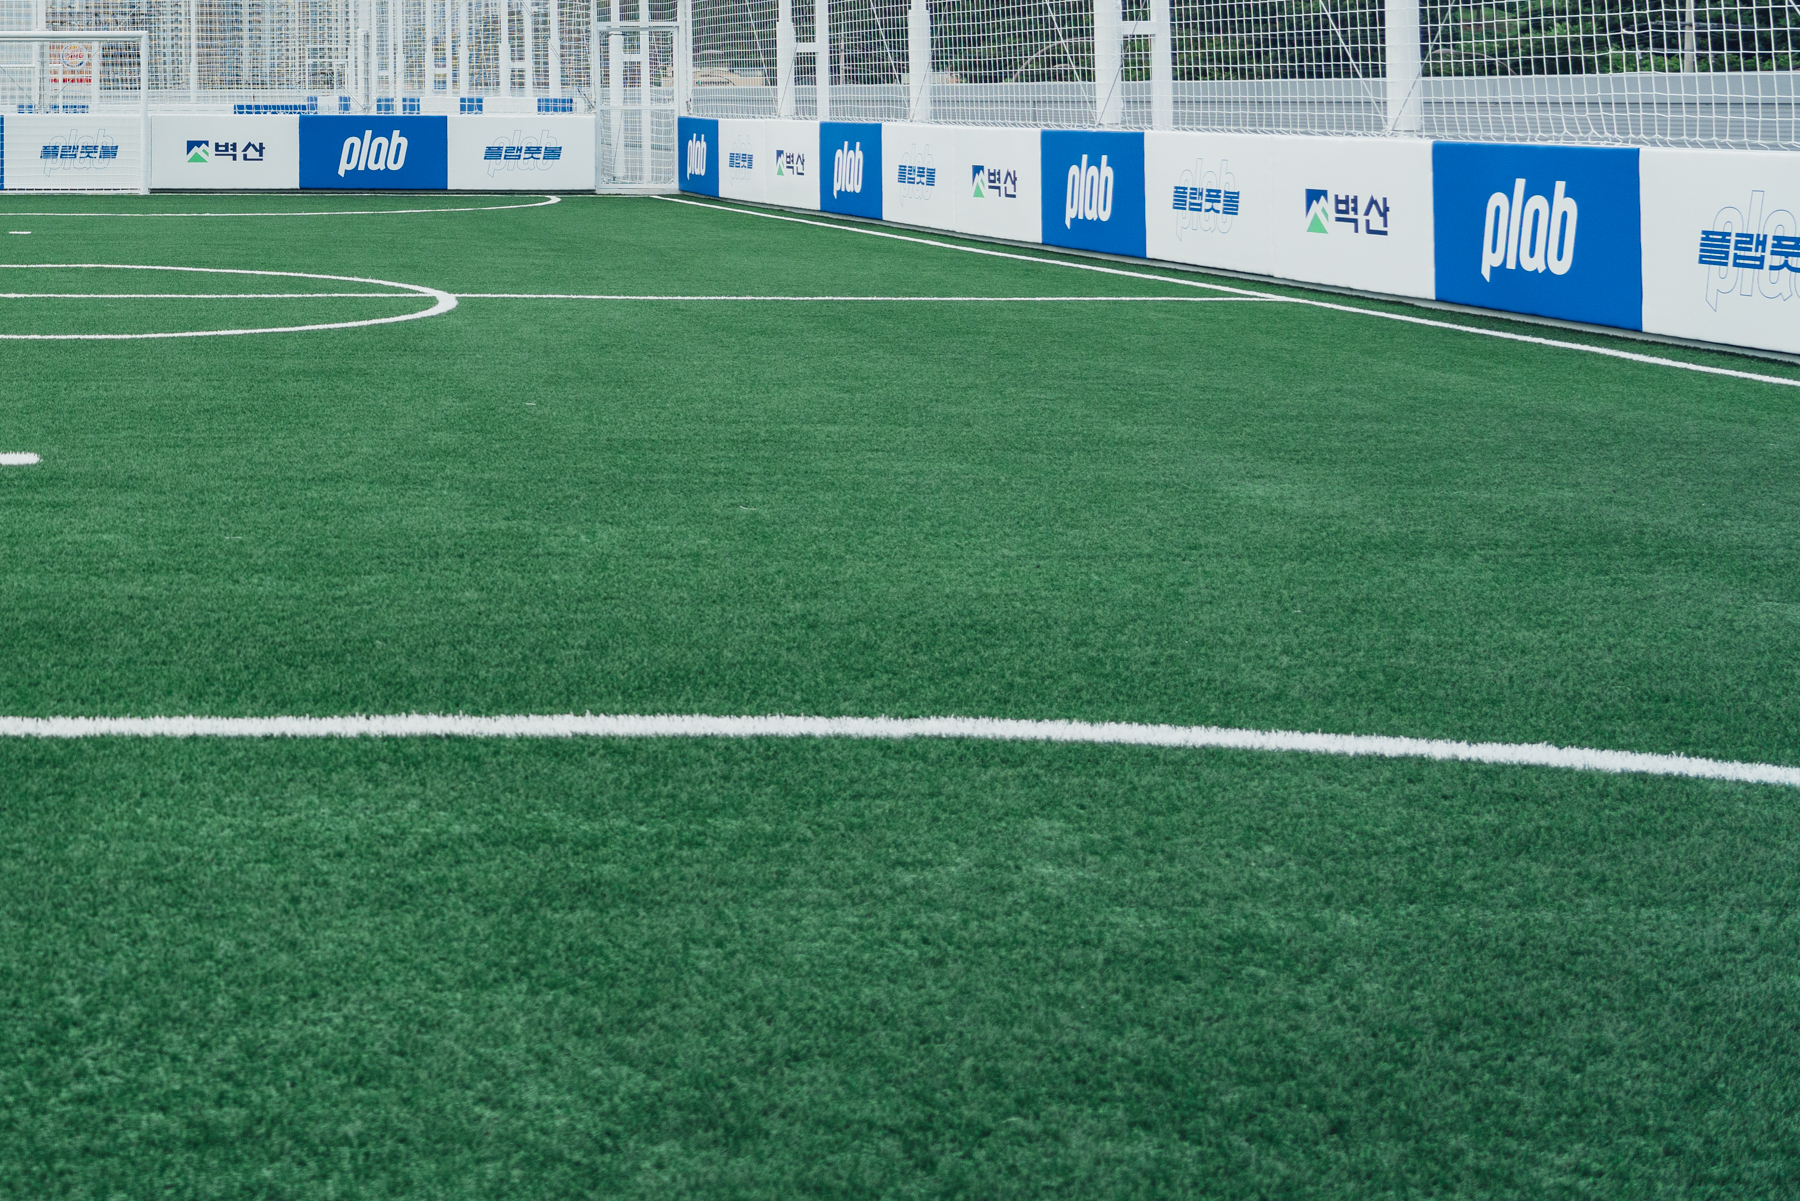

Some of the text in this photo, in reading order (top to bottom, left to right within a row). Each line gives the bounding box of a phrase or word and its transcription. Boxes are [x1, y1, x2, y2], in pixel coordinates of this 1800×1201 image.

[39, 144, 119, 159] 플랩풋볼
[214, 141, 266, 162] 벽산
[337, 129, 409, 178] plab
[483, 146, 563, 161] 플랩풋볼
[686, 133, 707, 180] plab
[786, 152, 805, 176] 벽산
[833, 140, 864, 199] plab
[897, 164, 936, 187] 플랩풋볼
[987, 168, 1018, 199] 벽산
[1064, 154, 1114, 230] plab
[1172, 185, 1240, 216] 플랩풋볼
[1334, 194, 1390, 236] 벽산
[1480, 177, 1578, 283] plab
[1705, 189, 1800, 312] pla
